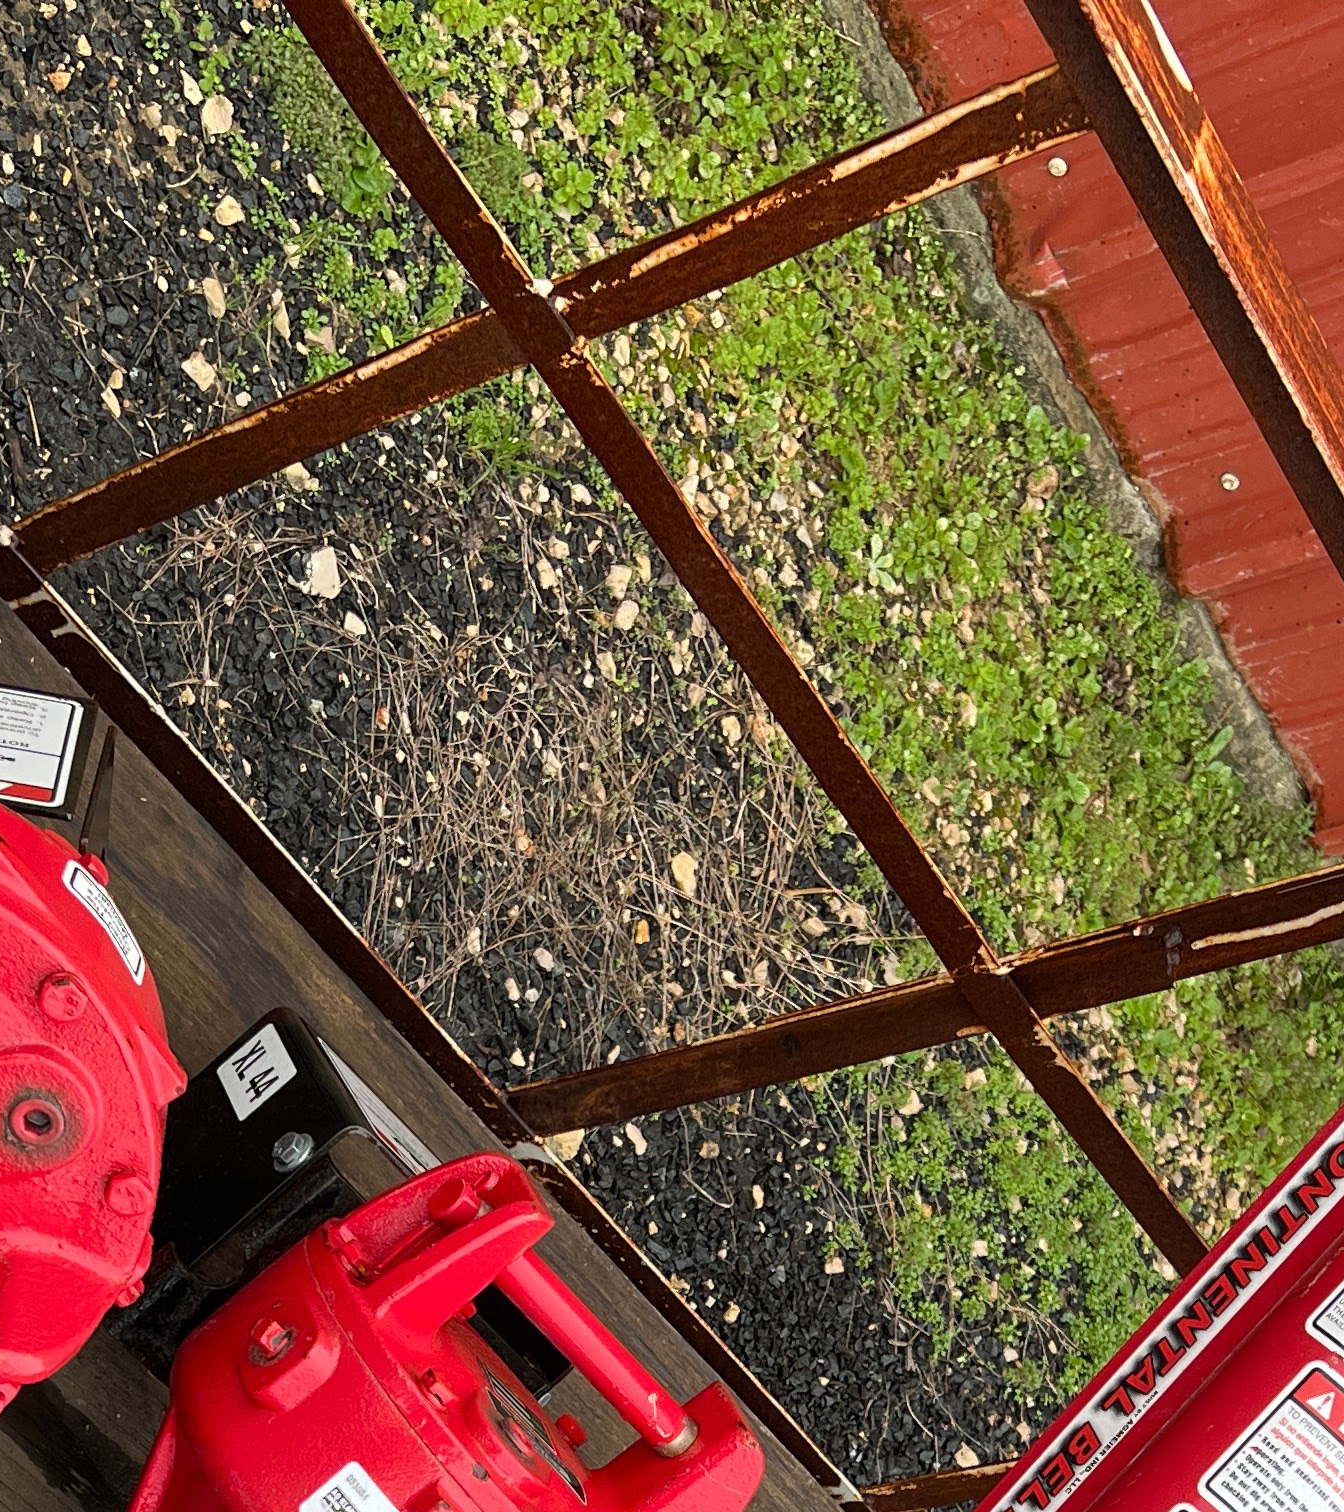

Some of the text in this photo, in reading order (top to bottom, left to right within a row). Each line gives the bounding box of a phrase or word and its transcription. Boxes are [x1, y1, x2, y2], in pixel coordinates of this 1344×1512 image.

[231, 1039, 280, 1104] XL 44
[1097, 1417, 1135, 1457] AGMEIER
[1297, 1416, 1338, 1453] PREVENT
[1063, 1476, 1081, 1494] LLC
